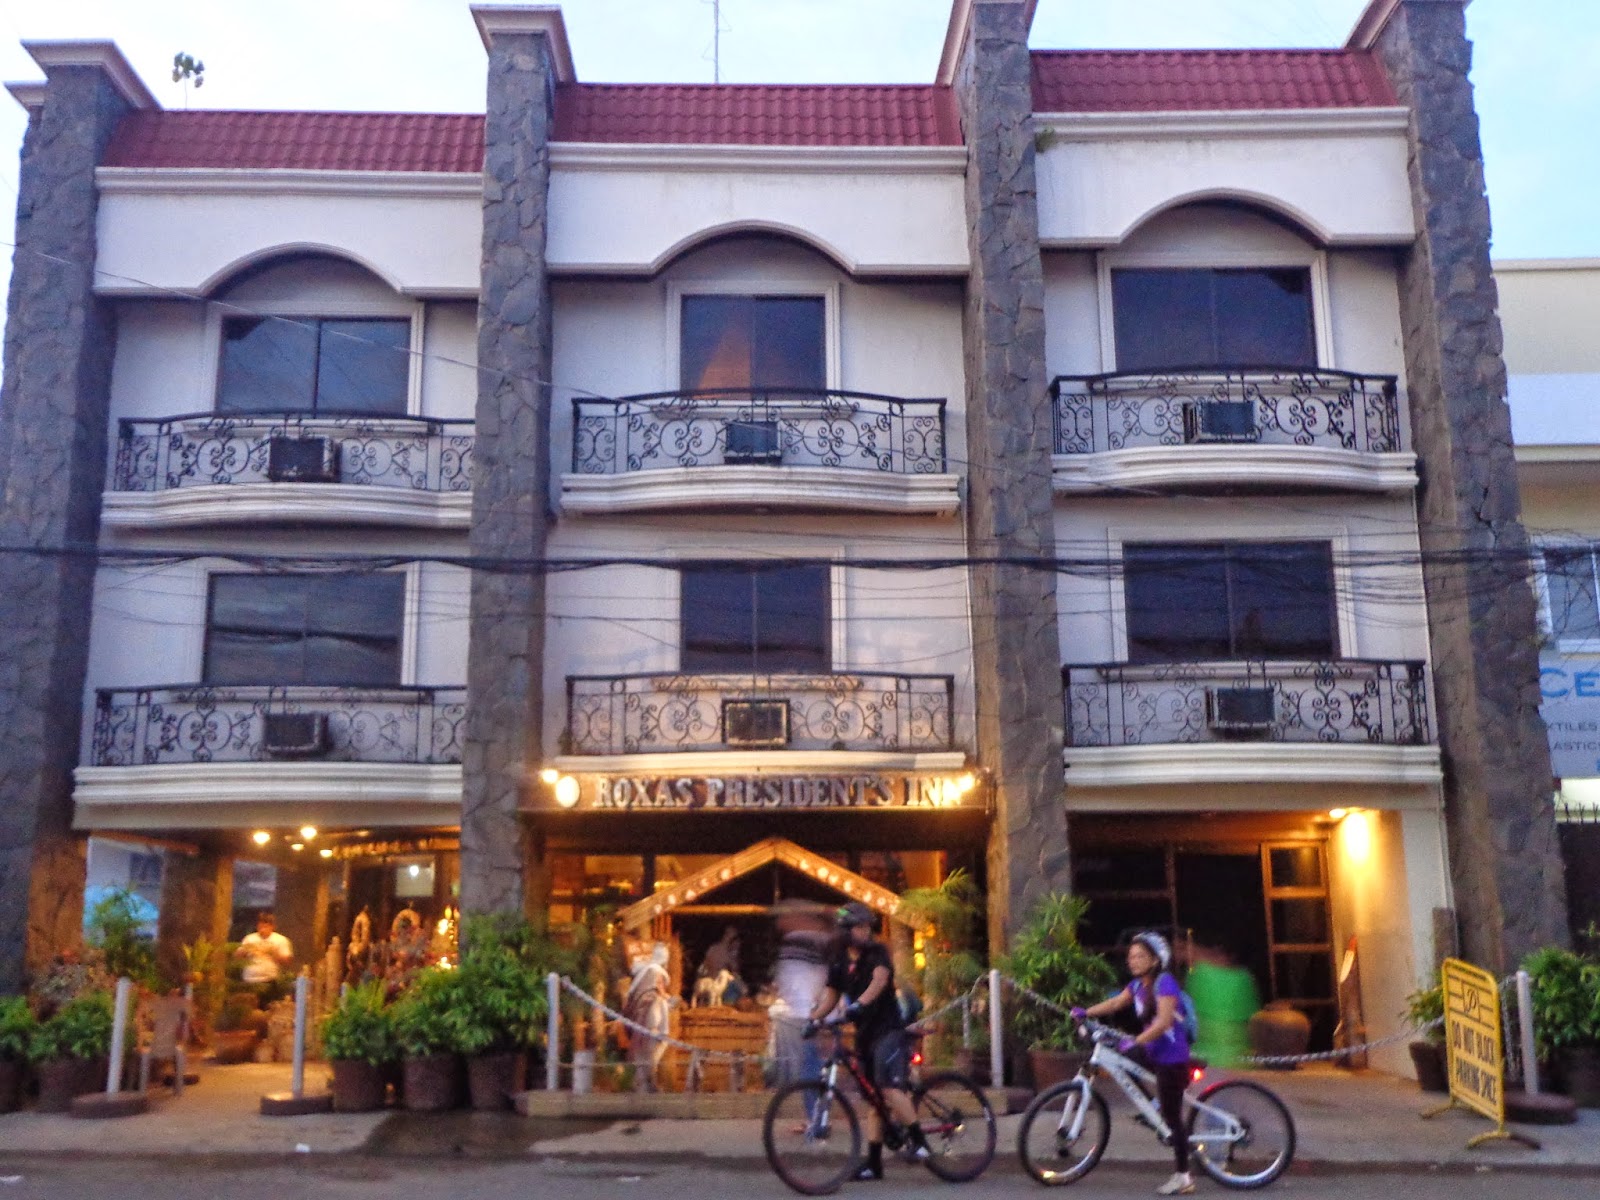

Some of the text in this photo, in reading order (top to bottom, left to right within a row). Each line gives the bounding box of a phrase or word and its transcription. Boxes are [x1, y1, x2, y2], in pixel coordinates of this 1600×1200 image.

[1553, 741, 1600, 752] ASTIC
[592, 777, 693, 809] ROXAS
[703, 776, 895, 808] PRESIDENT'S
